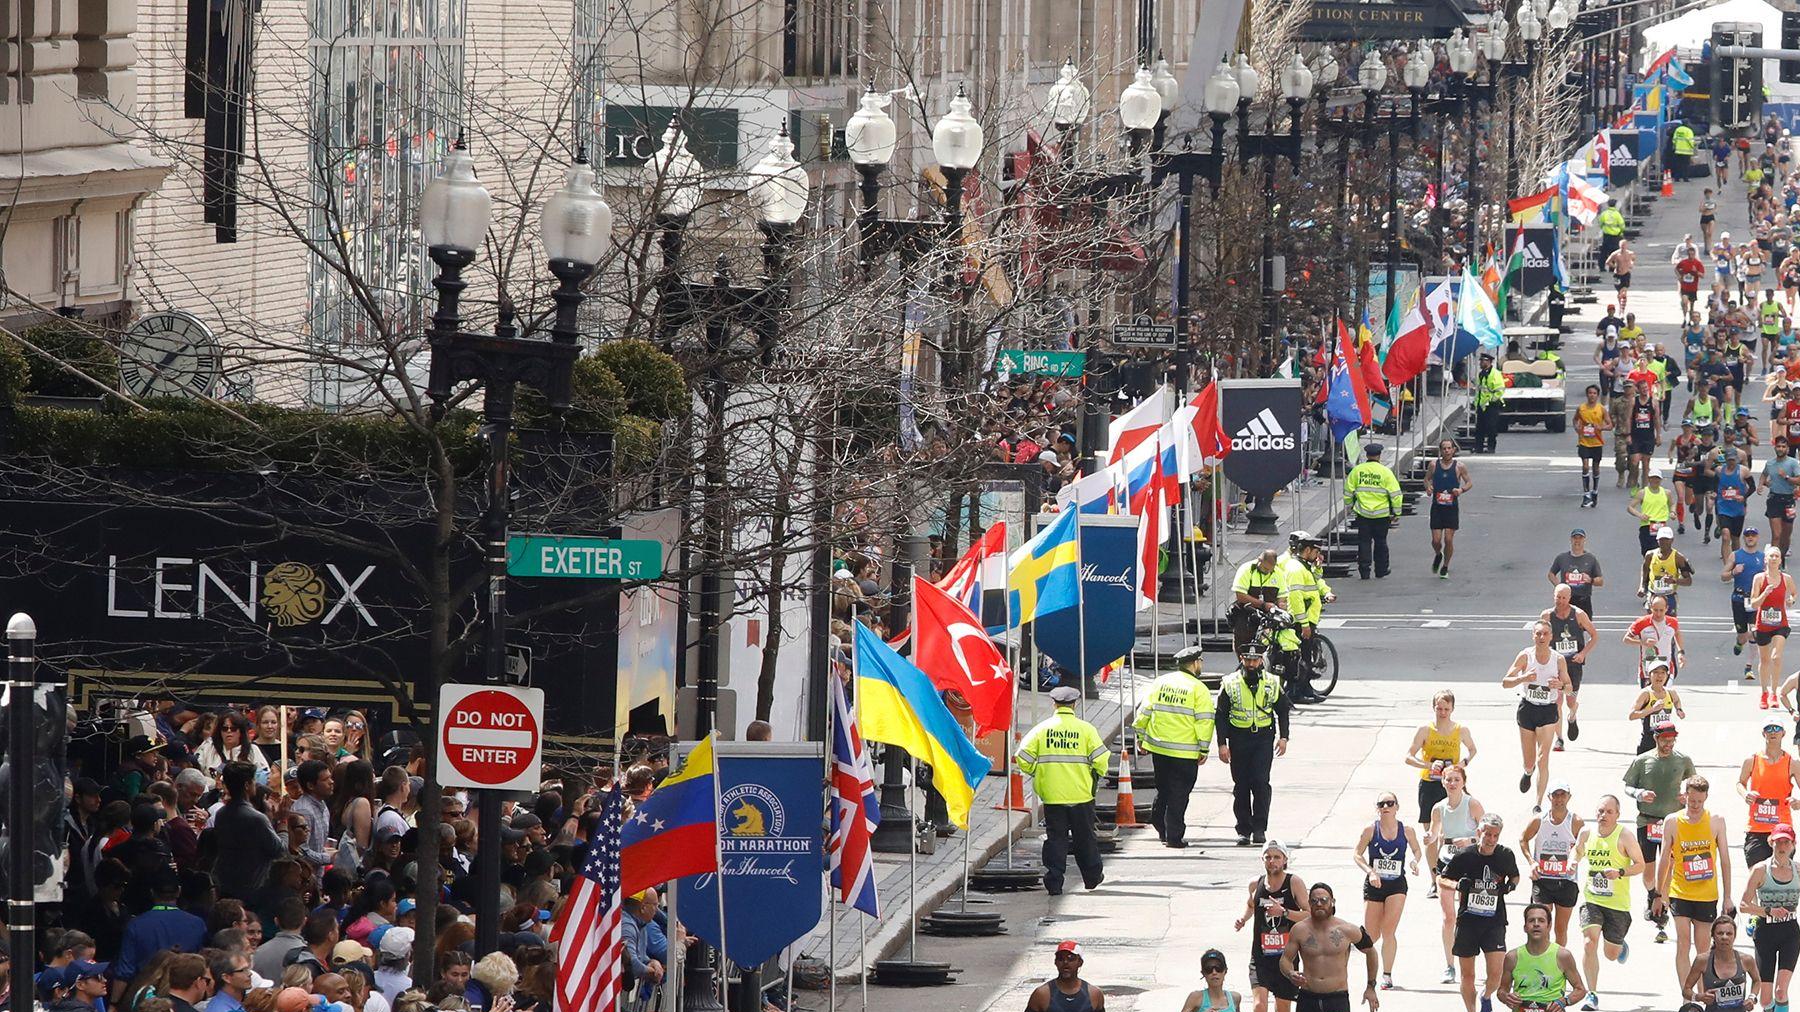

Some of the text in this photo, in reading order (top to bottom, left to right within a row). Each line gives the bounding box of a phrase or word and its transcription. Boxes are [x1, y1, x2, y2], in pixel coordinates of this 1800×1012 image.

[1359, 9, 1424, 22] CENTER
[1611, 156, 1638, 167] didas
[1522, 254, 1549, 268] idas
[1022, 354, 1049, 372] RING
[1231, 434, 1294, 451] adidas
[541, 546, 643, 576] EXETER ST
[1081, 562, 1134, 592] Hancock
[1159, 682, 1189, 695] Boston
[1157, 691, 1187, 705] Police
[456, 710, 527, 728] DO NOT
[1046, 728, 1079, 739] Boston
[1046, 738, 1079, 750] Police
[462, 747, 518, 765] ENTER
[722, 786, 758, 804] ATHLETIC
[757, 788, 783, 834] ASSOCIATION
[740, 840, 810, 851] MARATHON
[1587, 849, 1610, 857] TEAM
[736, 855, 799, 885] Hancock
[1378, 860, 1397, 871] 9926
[1474, 881, 1497, 890] DALLAS
